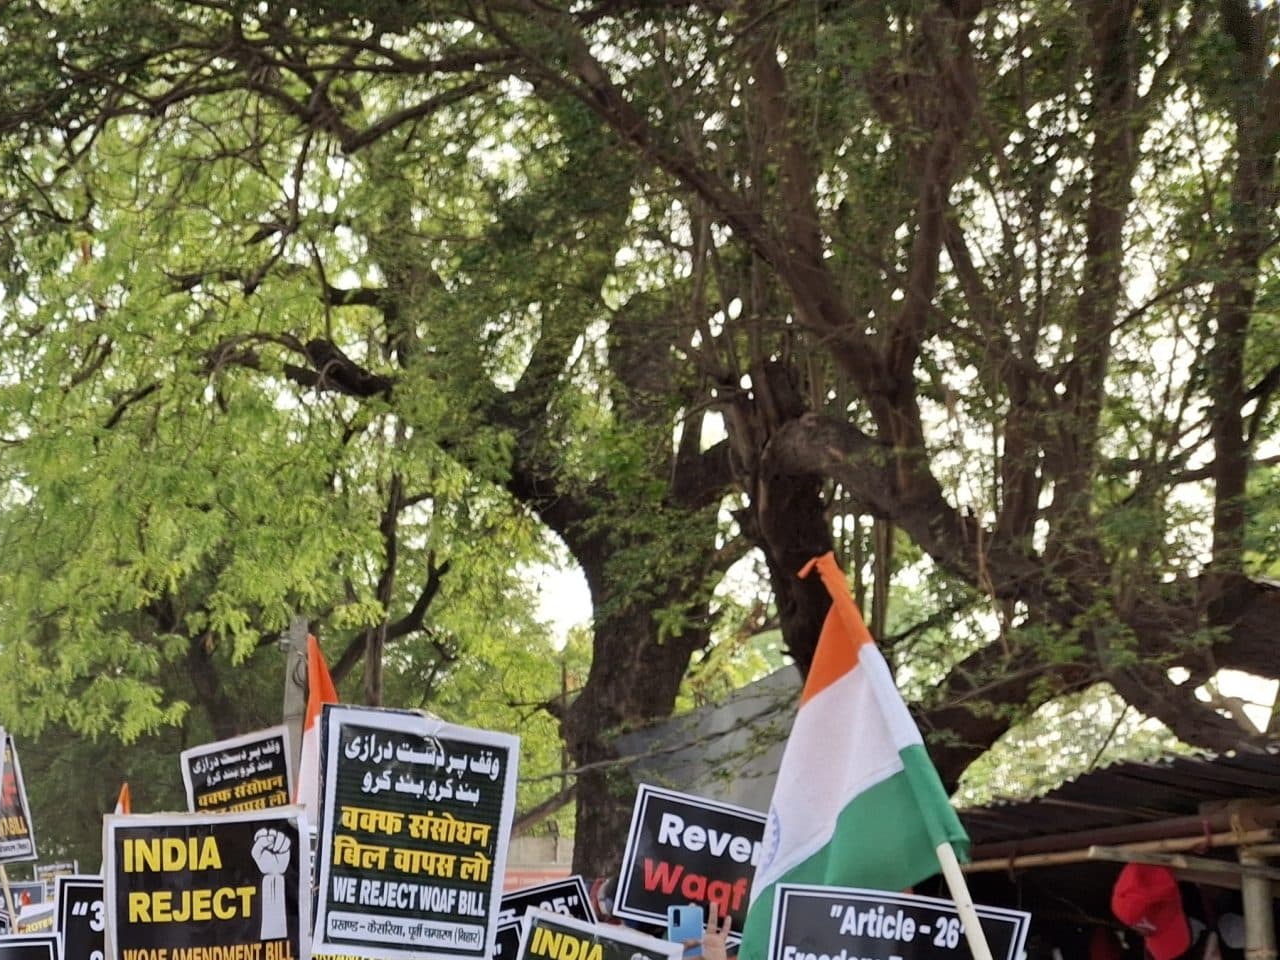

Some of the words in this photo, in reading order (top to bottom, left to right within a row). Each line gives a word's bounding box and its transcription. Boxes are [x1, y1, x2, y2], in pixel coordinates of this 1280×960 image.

[341, 805, 404, 835] वक्फ
[409, 810, 491, 848] संसोधन
[658, 812, 763, 867] Rever
[123, 836, 222, 873] INDIA
[333, 835, 390, 870] बिल
[394, 846, 456, 878] वापस
[460, 852, 491, 882] लो
[128, 886, 257, 923] REJECT
[333, 876, 356, 904] WE
[360, 880, 418, 908] REJECT
[420, 886, 456, 914] WQAF
[458, 890, 485, 917] BILL
[643, 857, 748, 919] Waqf
